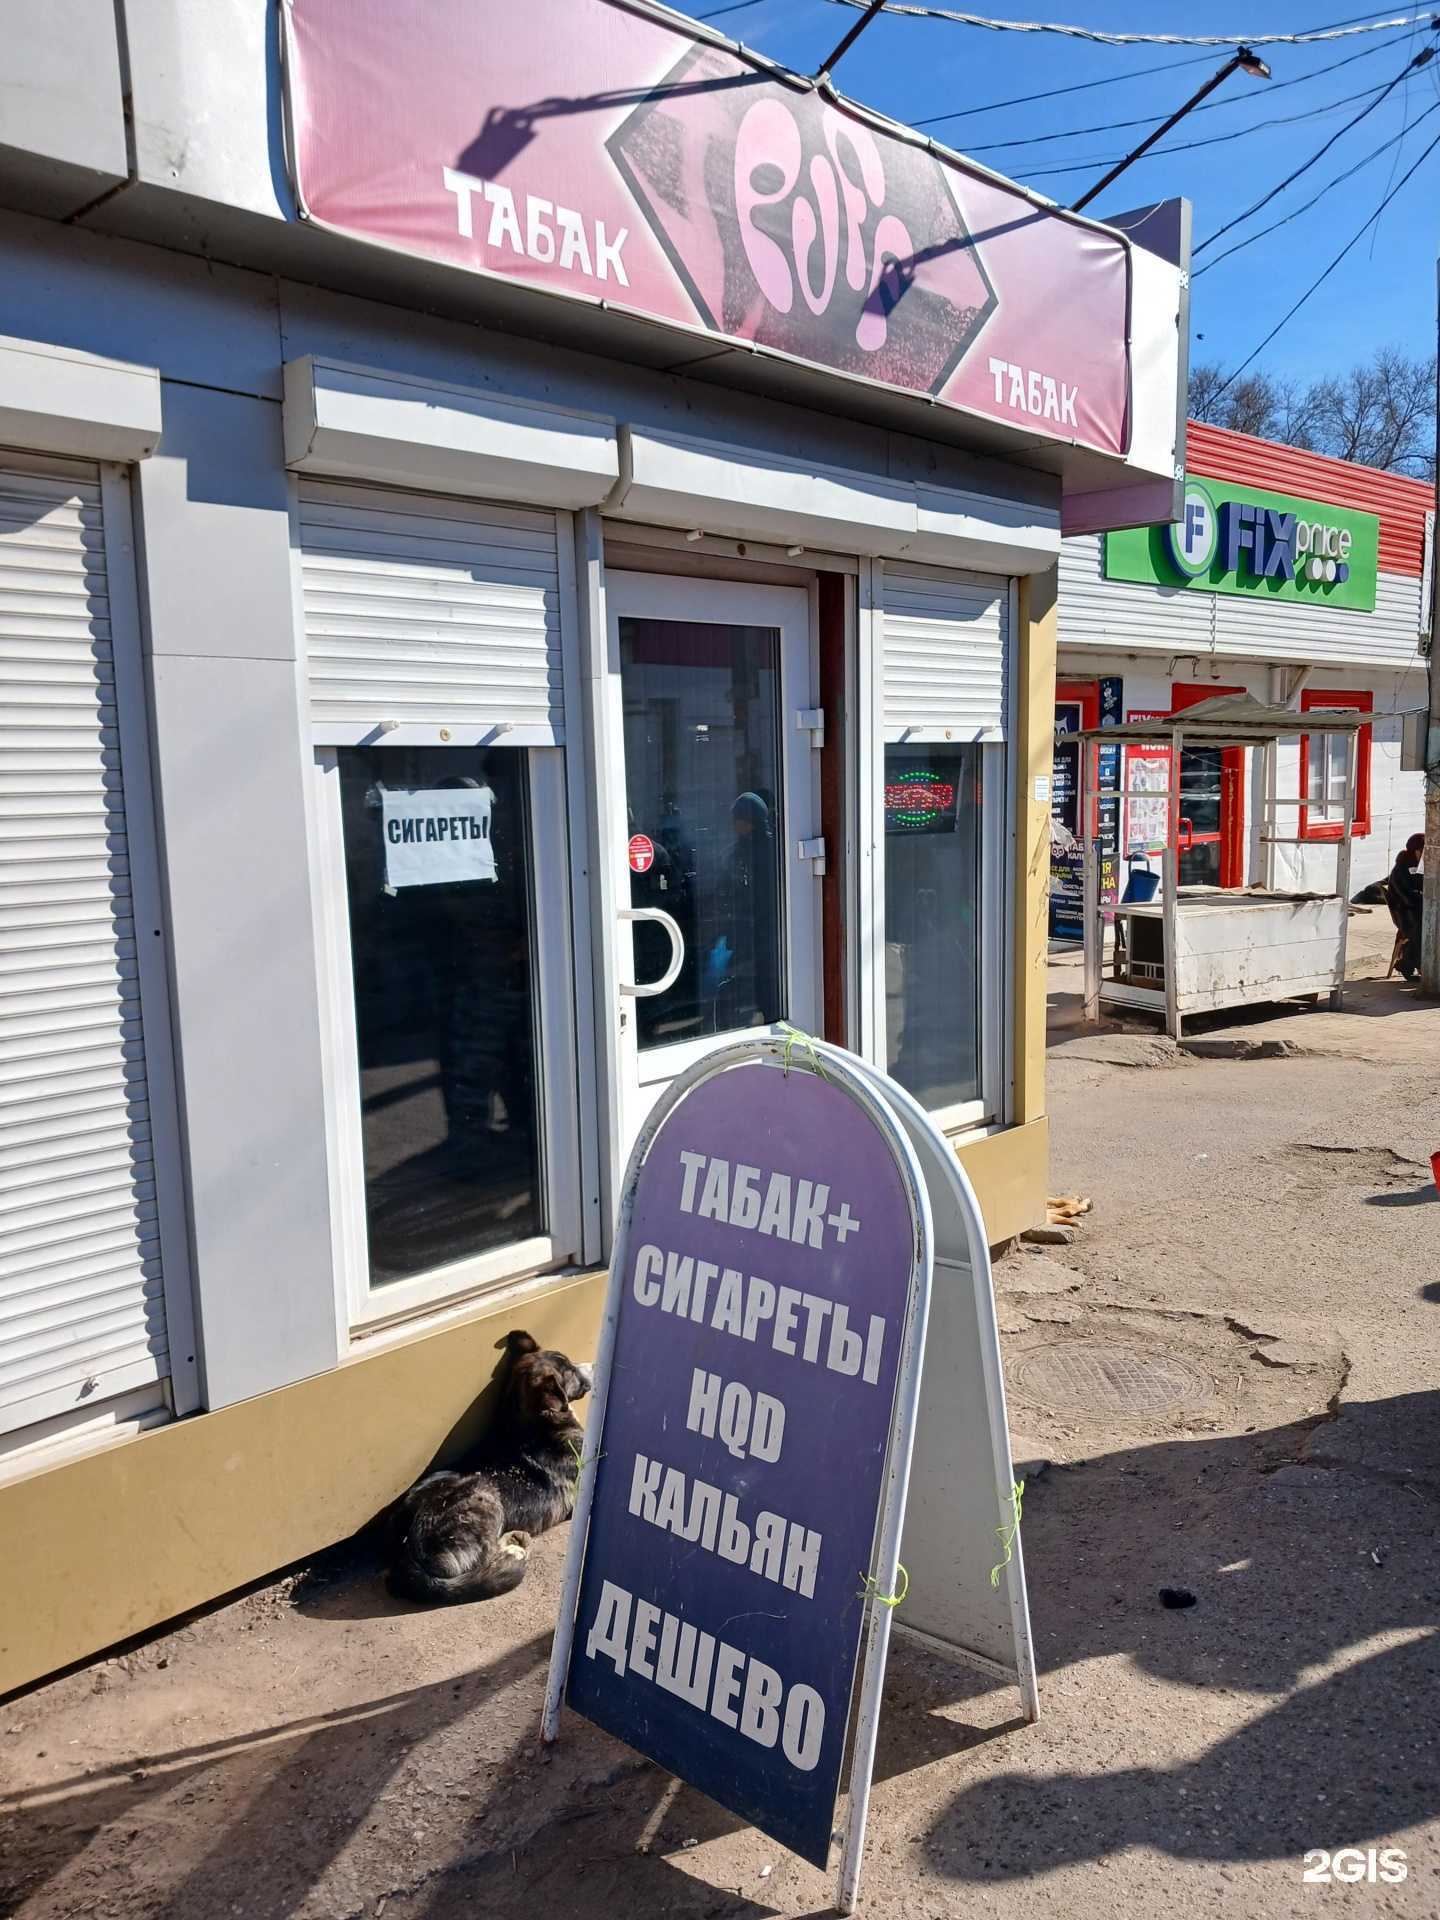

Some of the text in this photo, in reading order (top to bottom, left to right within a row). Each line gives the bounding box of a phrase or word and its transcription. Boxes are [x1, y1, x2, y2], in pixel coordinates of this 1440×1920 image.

[442, 167, 630, 288] ТАБАК
[988, 357, 1079, 428] ТАБАК
[1295, 518, 1353, 561] price
[387, 815, 489, 845] СИГАРЕТЫ
[679, 1150, 860, 1250] ТАБАК+
[633, 1244, 886, 1385] СИГАРЕТЫ
[686, 1367, 786, 1463] HQD
[628, 1453, 823, 1600] КАЛЬЯН
[586, 1579, 826, 1772] ДЕШЕВО
